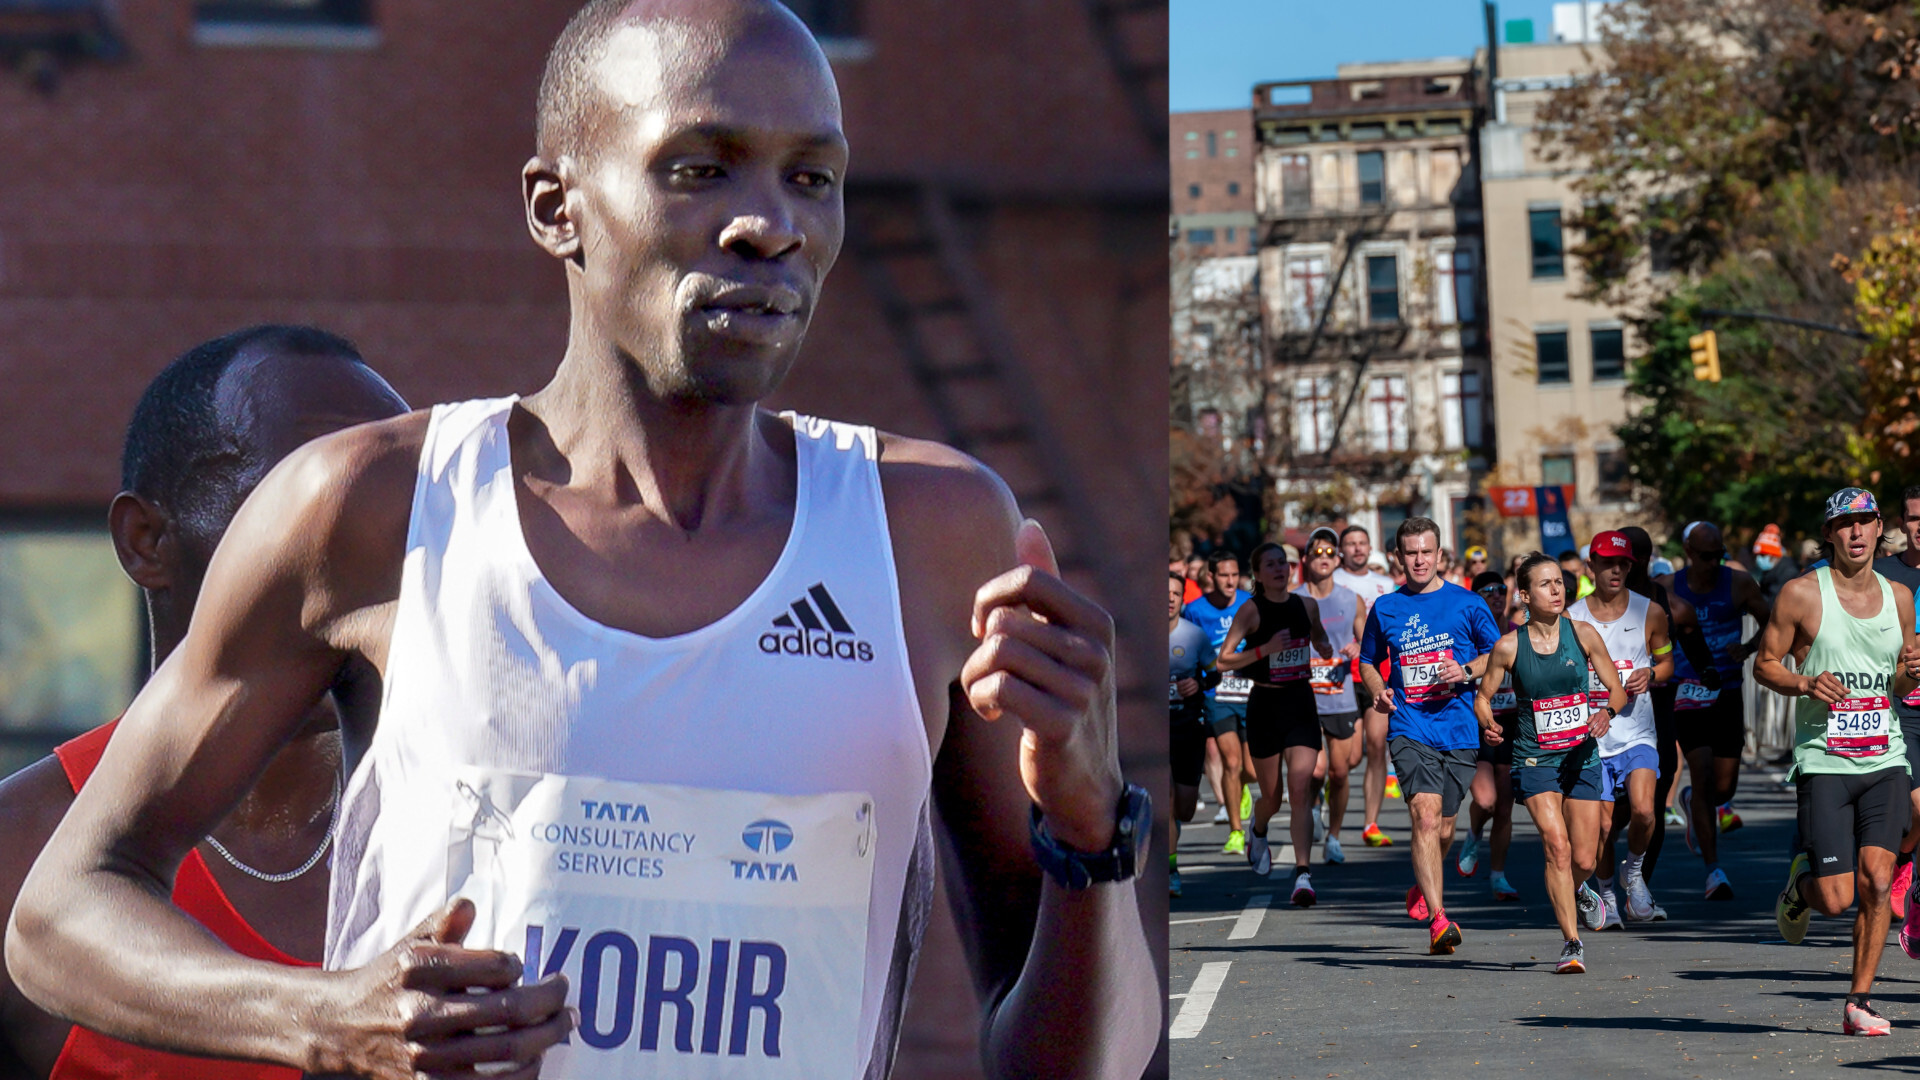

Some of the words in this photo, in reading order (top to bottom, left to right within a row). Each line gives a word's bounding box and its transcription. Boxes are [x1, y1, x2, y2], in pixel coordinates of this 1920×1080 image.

[1503, 490, 1529, 508] 22
[758, 628, 874, 662] adidas
[1405, 640, 1420, 650] RUN
[1420, 636, 1435, 646] FOR
[1277, 648, 1303, 663] 4991
[1409, 664, 1438, 682] 754
[1222, 678, 1249, 690] 5834
[1682, 684, 1712, 698] 3123
[1540, 701, 1553, 710] tcs
[1543, 707, 1580, 728] 7339
[1837, 711, 1881, 731] 5489
[580, 800, 650, 824] TATA
[531, 823, 697, 854] CONSULTANCY
[557, 852, 664, 879] SERVICES
[730, 860, 799, 882] TATA
